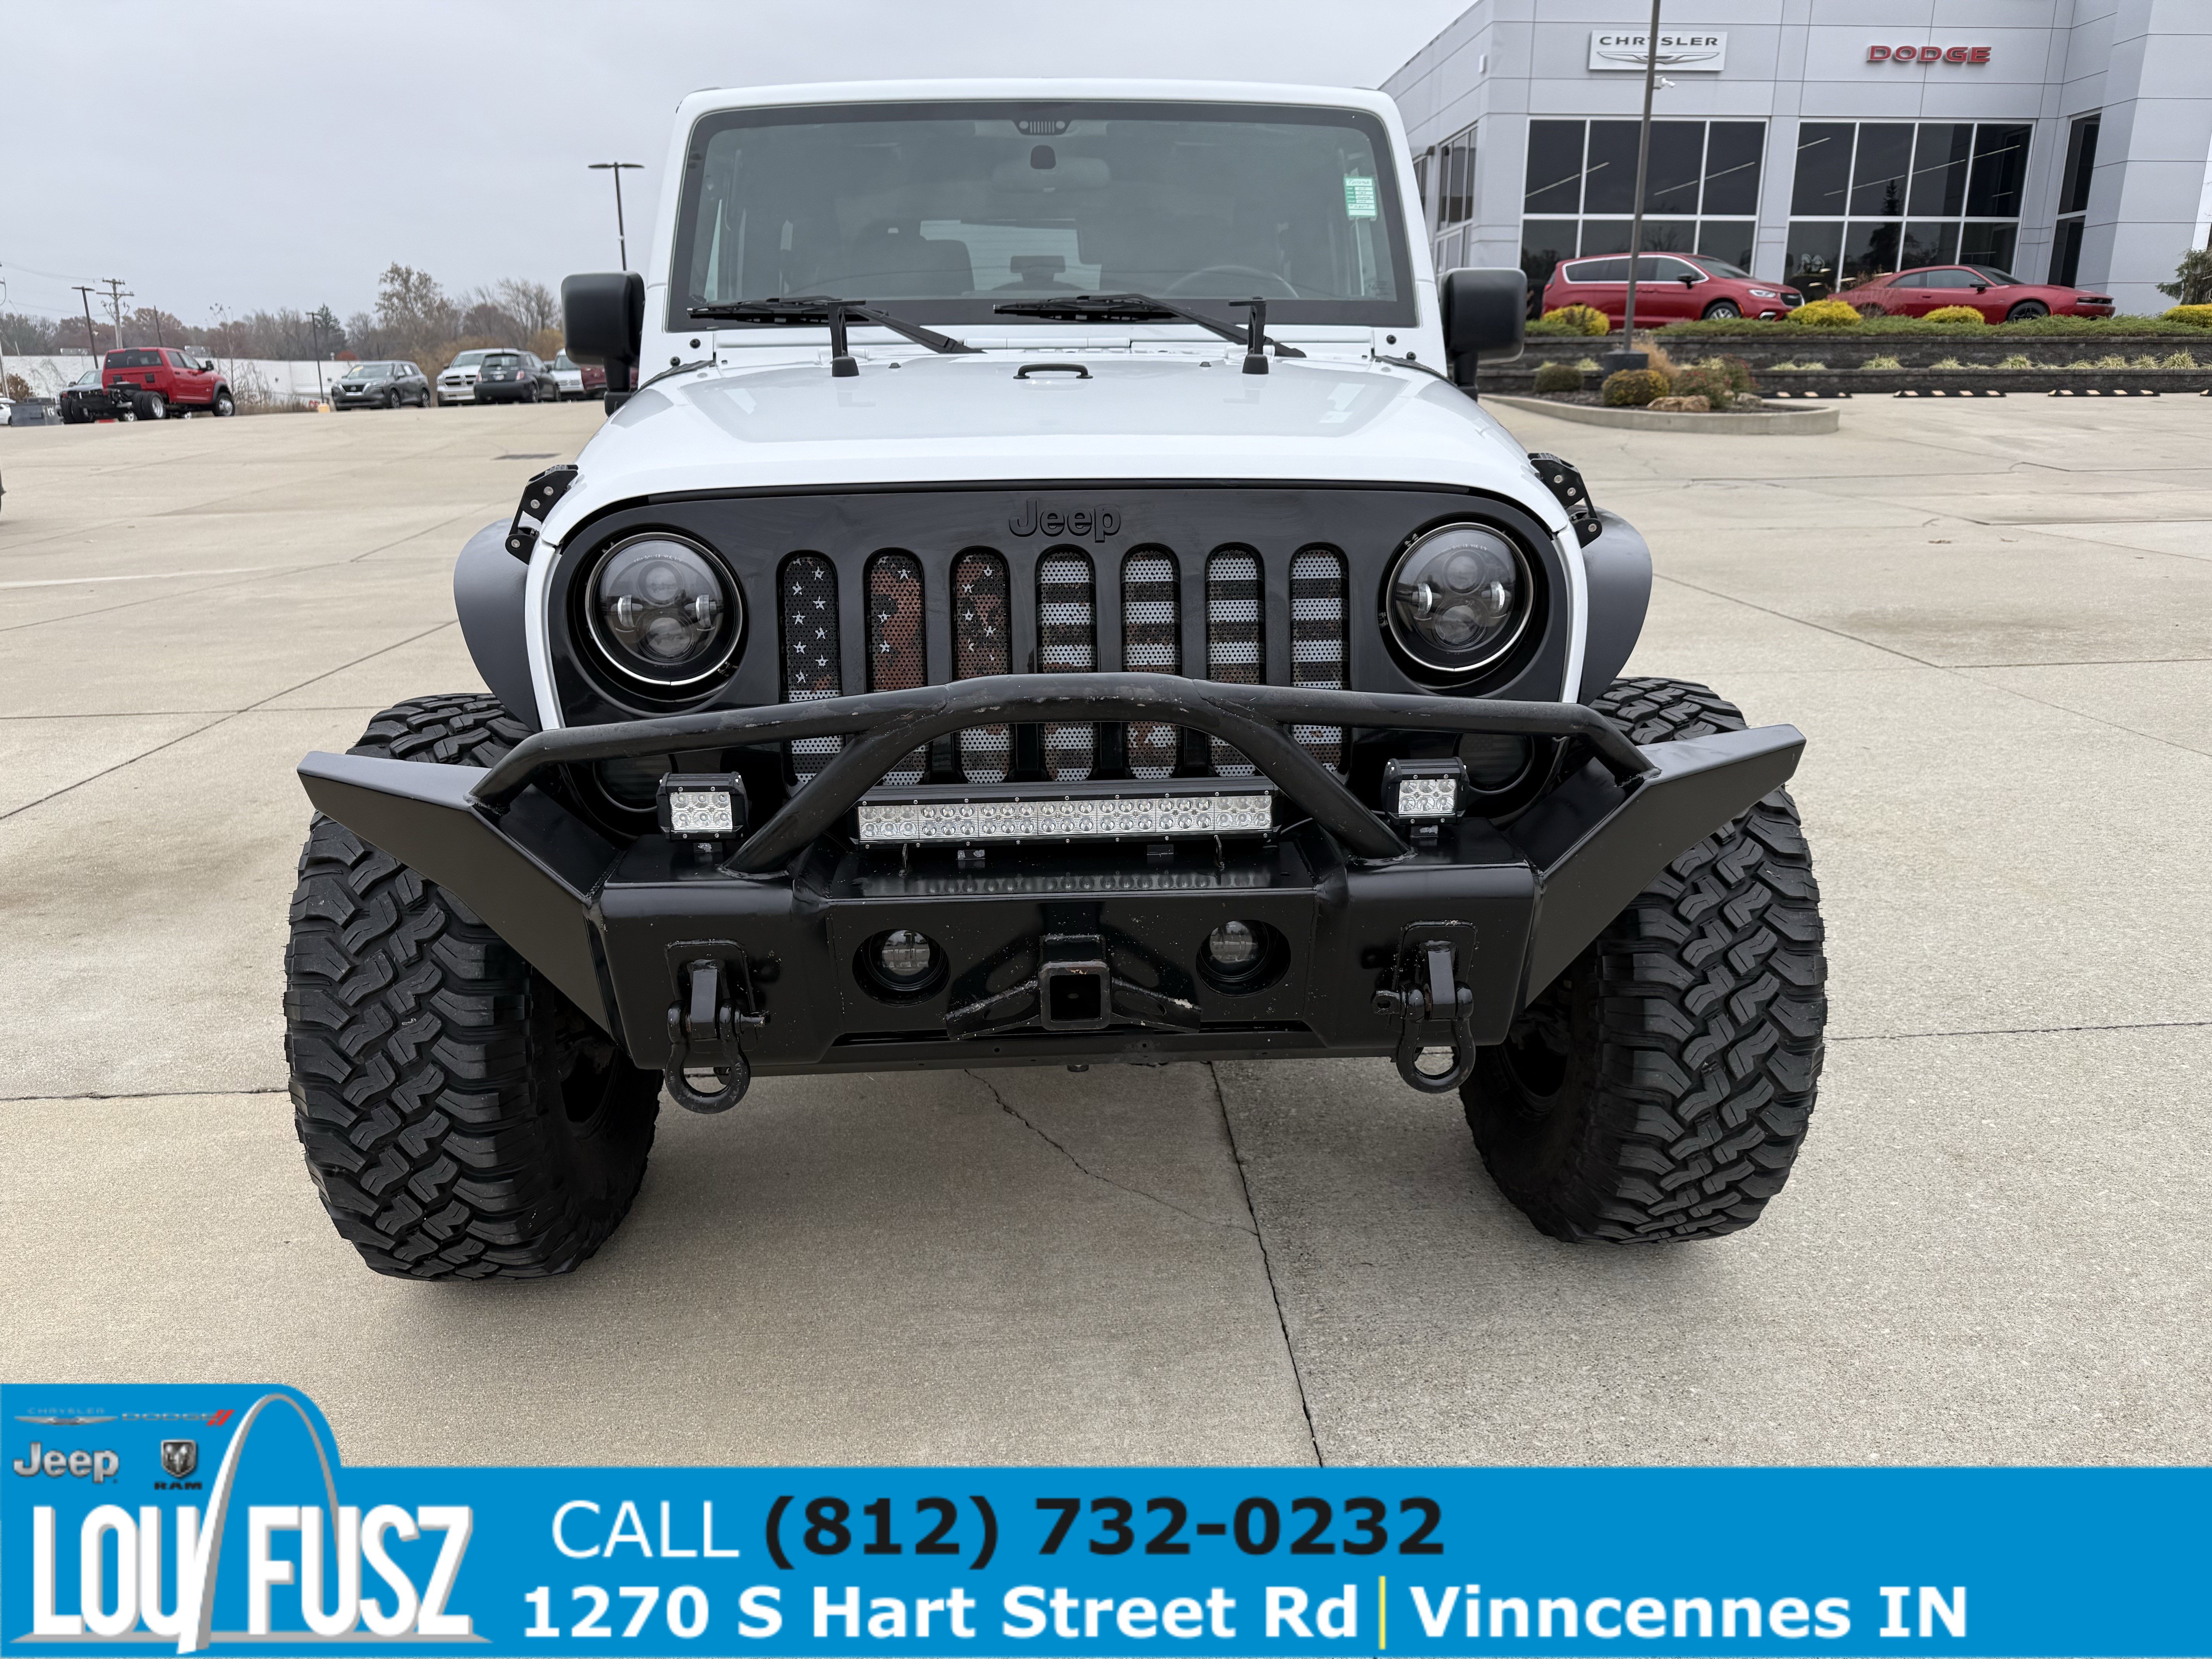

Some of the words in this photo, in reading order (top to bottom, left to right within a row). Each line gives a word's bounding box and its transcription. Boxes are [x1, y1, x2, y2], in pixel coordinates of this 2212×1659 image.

[1599, 37, 1718, 46] CHRSLER
[1867, 45, 1992, 62] DODGE
[1009, 498, 1121, 543] Jeep
